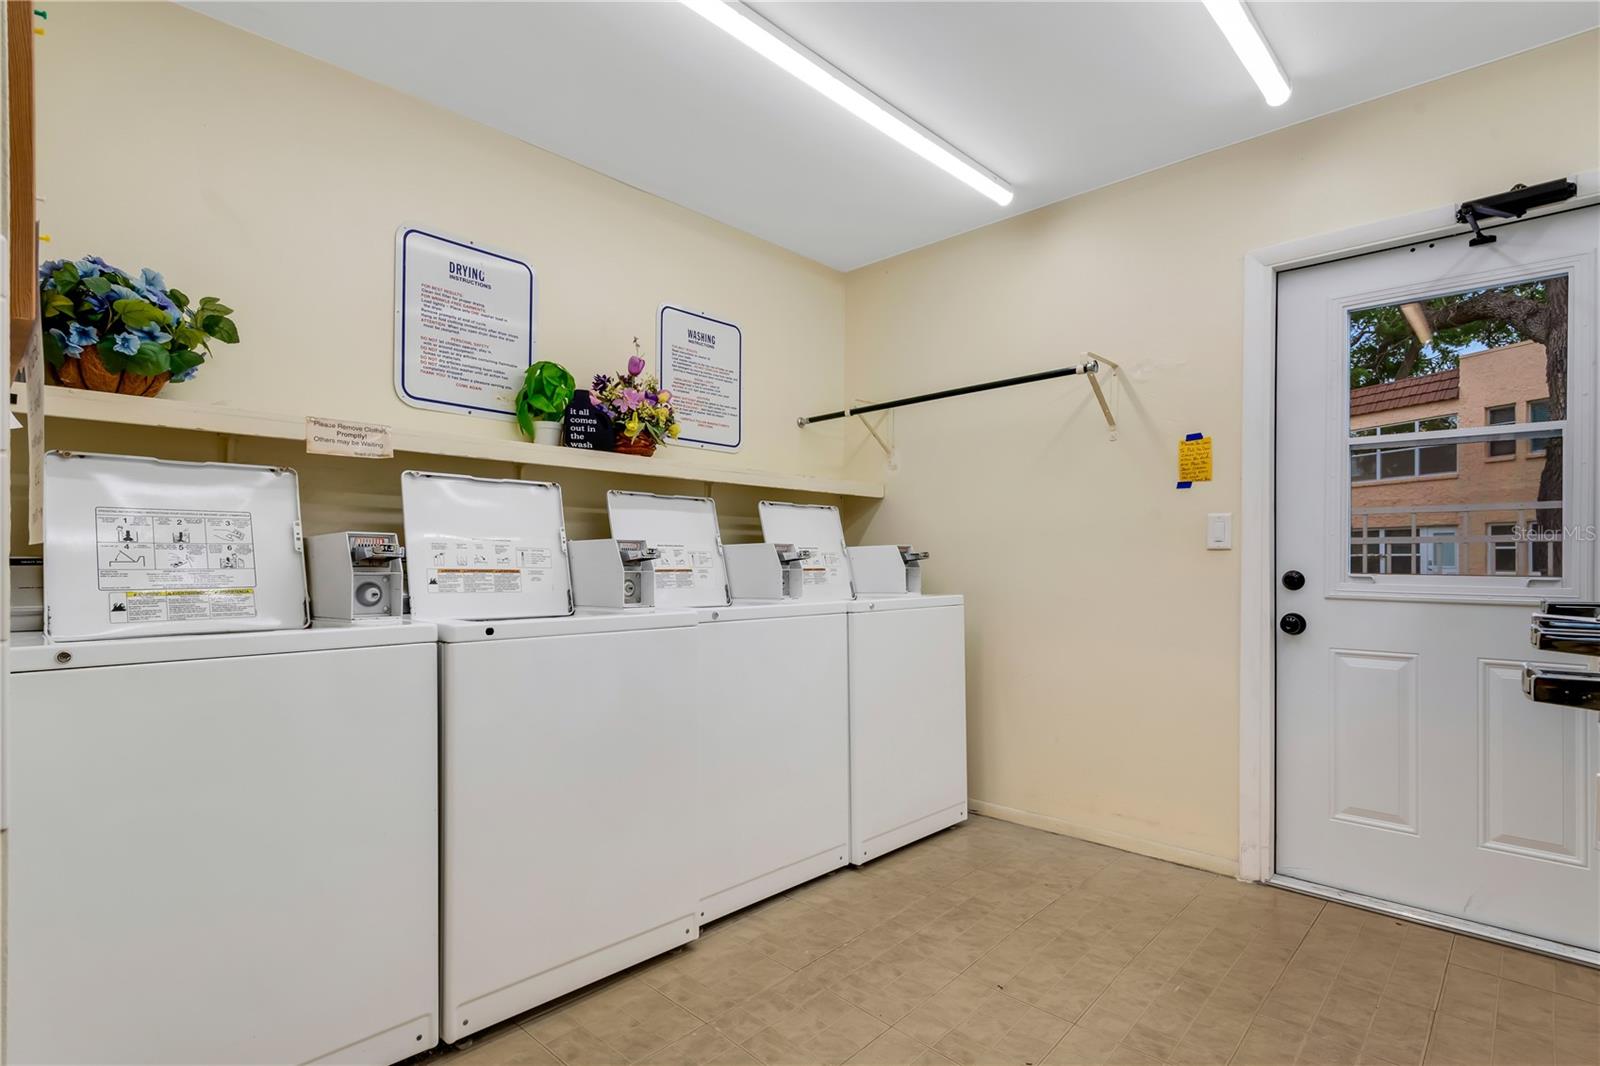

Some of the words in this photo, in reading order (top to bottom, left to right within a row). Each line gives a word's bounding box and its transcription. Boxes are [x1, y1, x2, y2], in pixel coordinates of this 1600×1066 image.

[449, 261, 485, 282] DRYING
[449, 274, 492, 290] INSTRUCTIONS
[688, 328, 715, 344] WASHING
[570, 407, 577, 415] it
[313, 420, 336, 429] Please
[337, 423, 363, 432] Remove
[313, 436, 335, 444] Others
[336, 430, 368, 440] Promptly!
